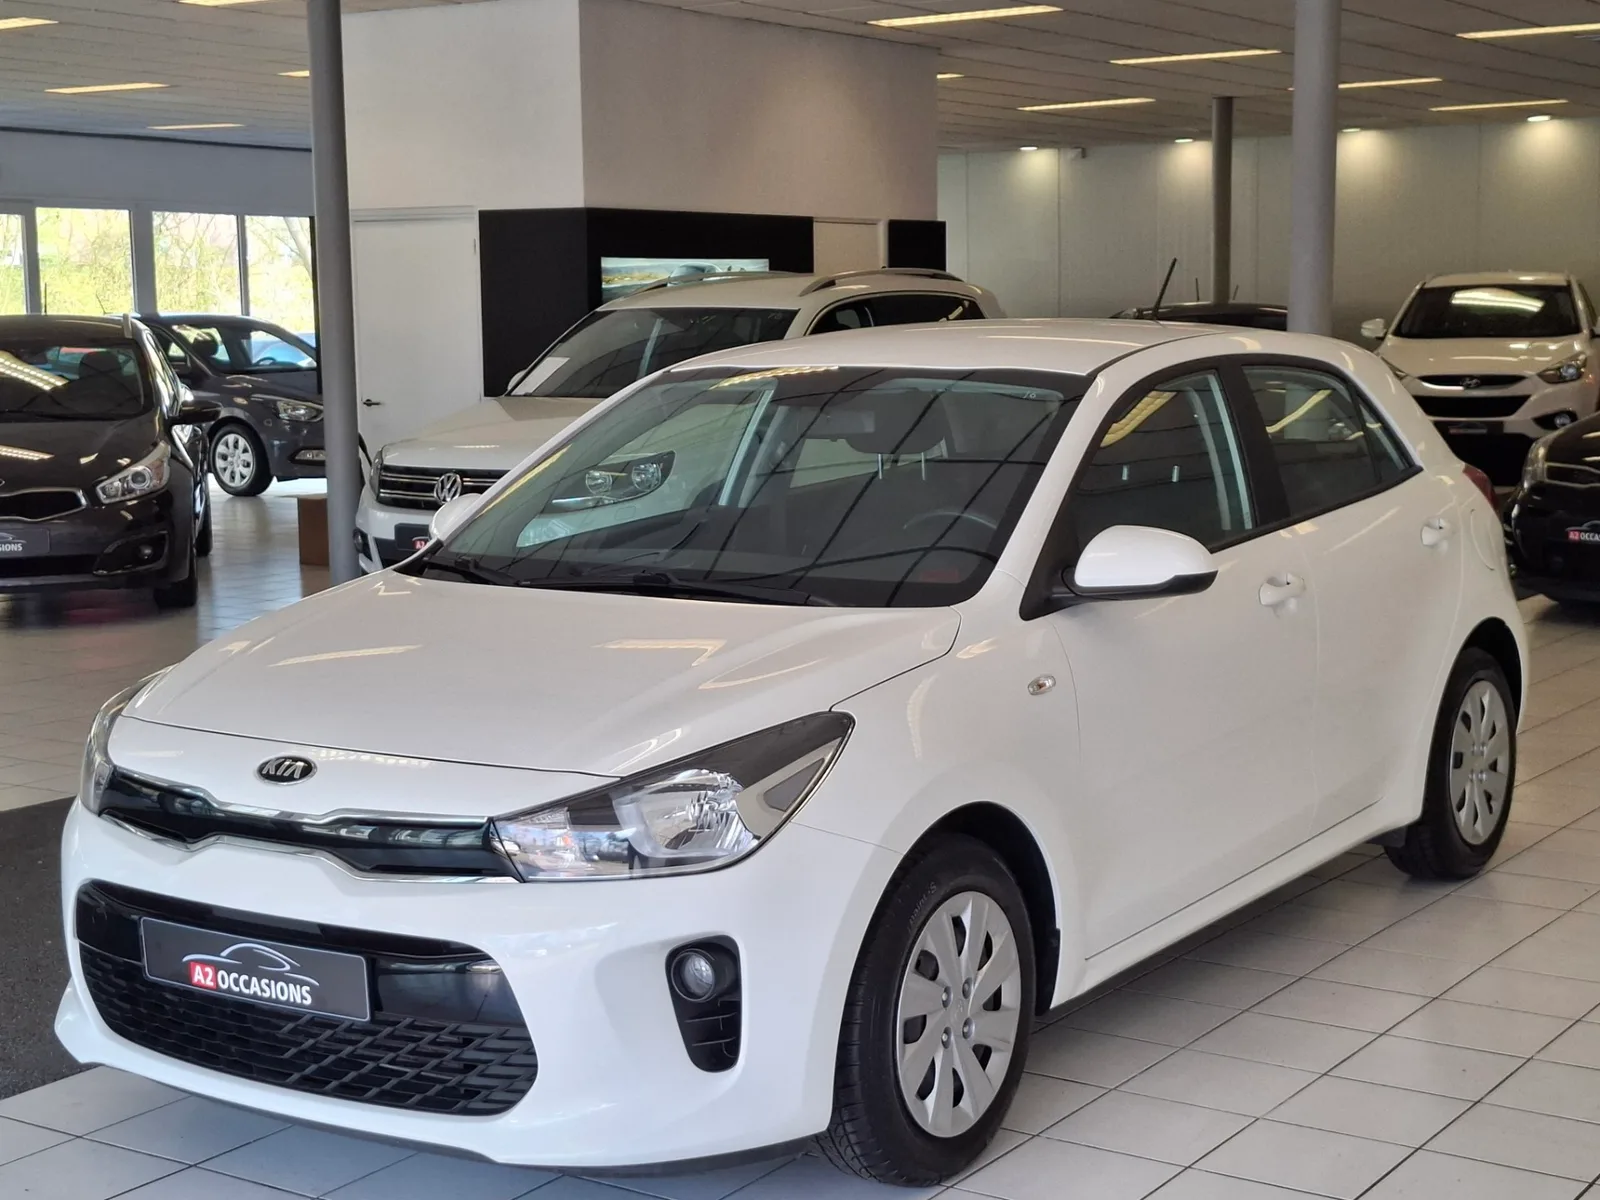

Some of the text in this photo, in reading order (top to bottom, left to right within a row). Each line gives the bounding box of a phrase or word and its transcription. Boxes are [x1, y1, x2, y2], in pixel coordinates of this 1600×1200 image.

[1580, 532, 1600, 541] OCCA
[261, 758, 308, 779] KIA
[193, 965, 312, 1005] A2 OCCASIONS
